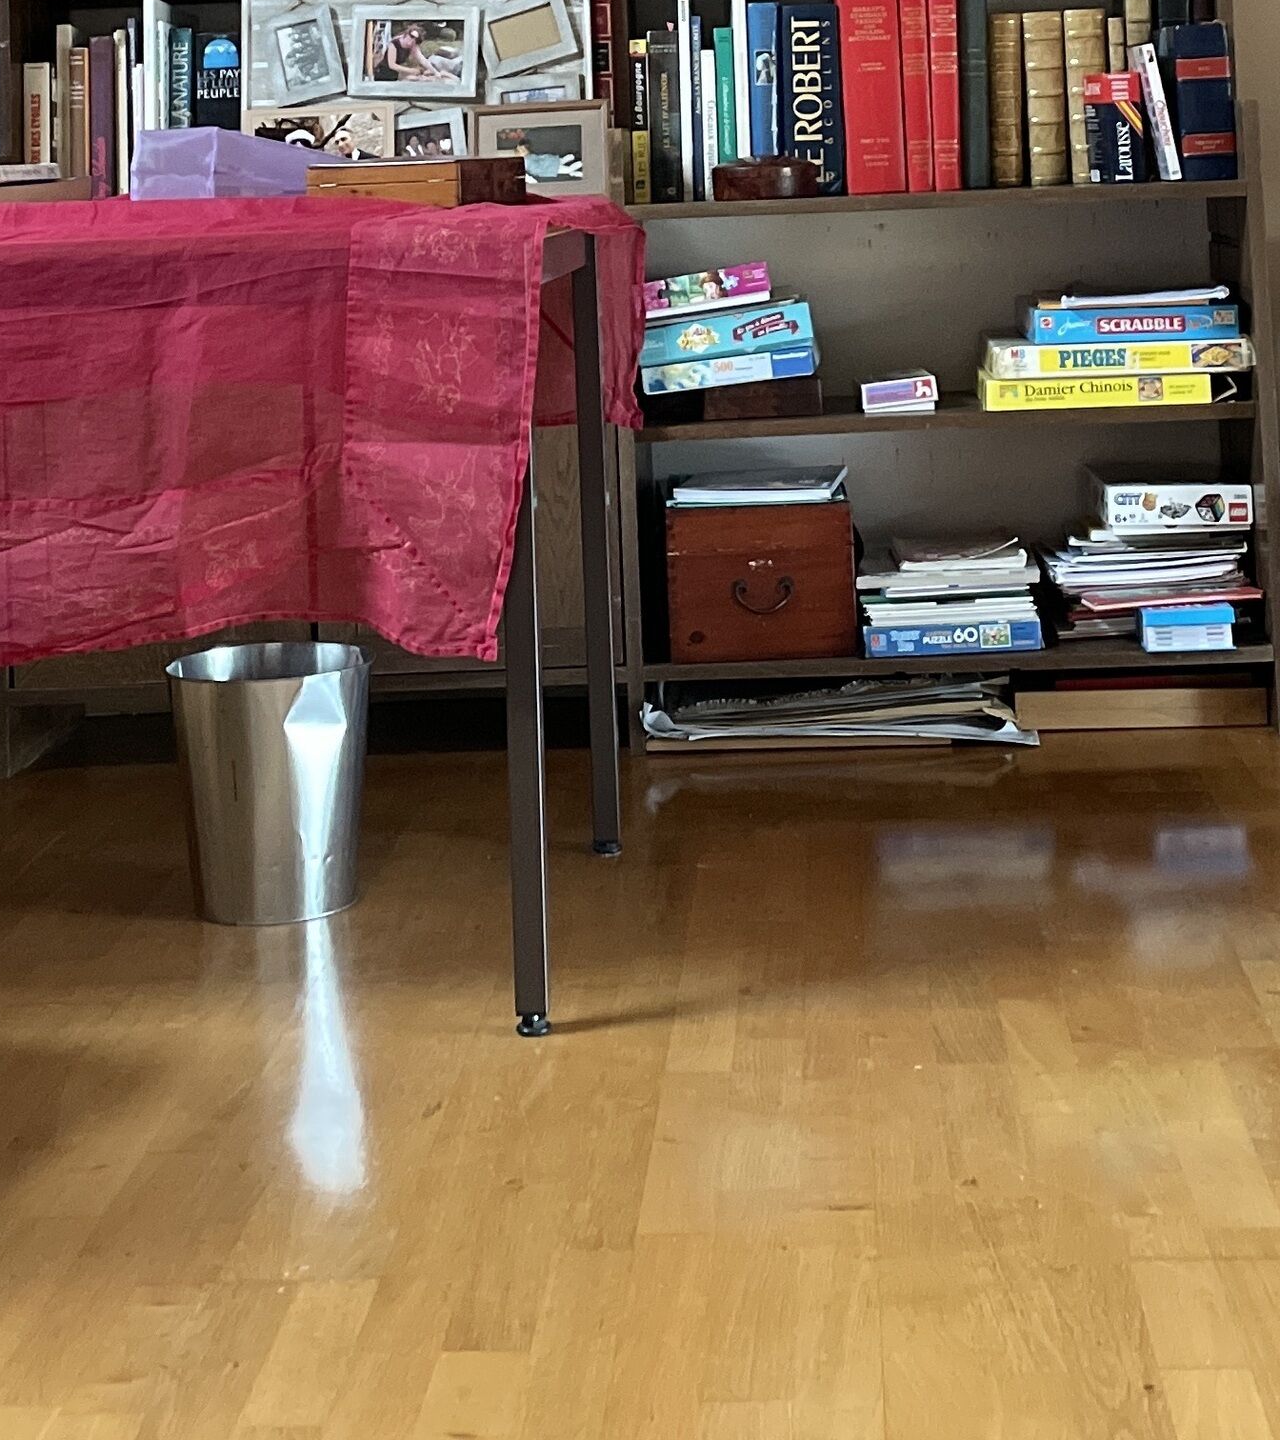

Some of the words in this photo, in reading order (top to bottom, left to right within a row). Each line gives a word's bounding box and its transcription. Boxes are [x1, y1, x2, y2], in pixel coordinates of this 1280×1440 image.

[173, 42, 190, 106] NATURE
[197, 69, 218, 79] LES
[220, 68, 241, 79] PAY
[791, 16, 824, 142] ROBERT
[821, 20, 834, 127] COLLINS
[197, 79, 210, 90] ET
[211, 79, 241, 89] LEUR
[634, 62, 645, 112] Bourgogne
[197, 89, 241, 100] PEUPLE
[172, 107, 191, 128] LA
[634, 112, 644, 126] La
[662, 120, 670, 135] LIT
[1115, 121, 1134, 181] Larousse
[1099, 316, 1183, 333] SCRABBLE
[1010, 348, 1026, 359] MB
[1058, 347, 1127, 369] PIEGES
[1024, 383, 1076, 397] Damier
[1079, 379, 1133, 393] Chinois
[1114, 492, 1142, 506] CITY
[1115, 514, 1128, 523] 6+
[922, 634, 953, 645] PUZZLE
[953, 626, 979, 644] 60
